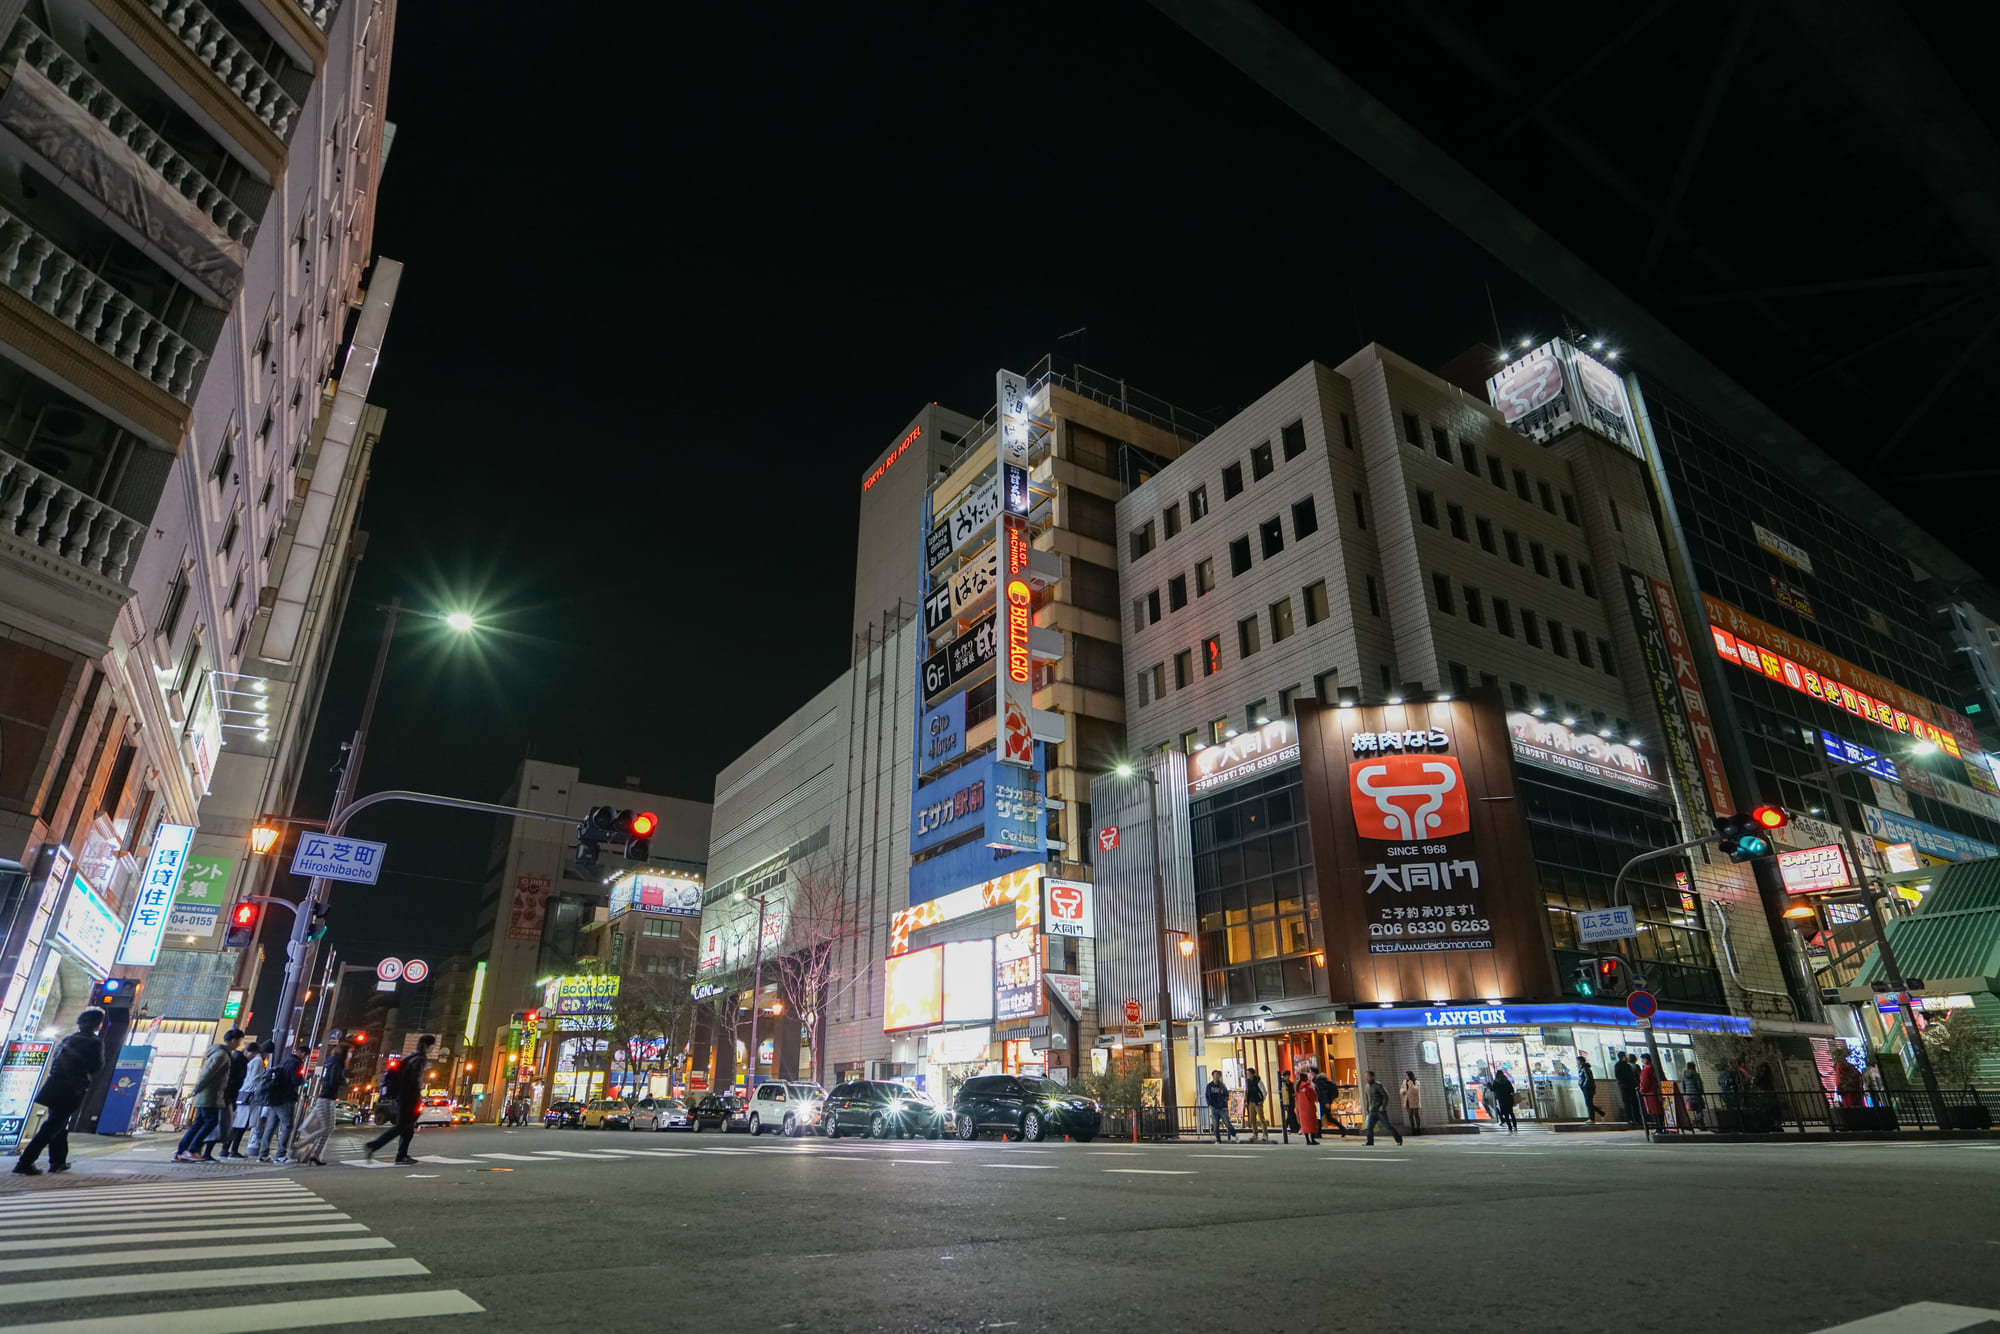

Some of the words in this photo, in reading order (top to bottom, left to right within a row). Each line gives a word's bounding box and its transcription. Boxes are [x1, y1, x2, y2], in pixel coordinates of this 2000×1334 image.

[864, 463, 885, 492] TOKYU
[886, 450, 897, 468] REI
[898, 425, 922, 455] HOTEL
[1010, 528, 1019, 576] PACHINKO
[1019, 541, 1028, 568] SLOT
[926, 587, 949, 628] 7F
[1706, 600, 1723, 624] 2F
[1009, 604, 1029, 683] BELLAGIO
[926, 663, 945, 692] 6F
[1761, 653, 1780, 678] 6F
[928, 733, 956, 760] House
[1352, 726, 1450, 752] 焼肉なら
[1257, 755, 1278, 769] 6330
[1280, 746, 1300, 761] 6263
[1568, 759, 1584, 771] 6330
[1584, 764, 1601, 775] 6263
[916, 779, 985, 837] エサカ駅前
[995, 799, 1044, 822] サウナ
[304, 839, 377, 866] 広芝町
[1387, 847, 1420, 857] SINCE
[1422, 844, 1448, 855] 1968
[299, 859, 372, 880] Hiroshibacho
[137, 849, 181, 927] 賃貸住宅
[1382, 920, 1404, 935] 06
[1406, 920, 1447, 934] 6330
[1450, 919, 1491, 933] 6263
[1582, 910, 1630, 930] 広芝町
[1583, 926, 1633, 940] Hiroshibacho
[1370, 938, 1493, 953] http://www.daidomon.com
[409, 966, 423, 977] 50
[1424, 1009, 1508, 1027] LAWSON
